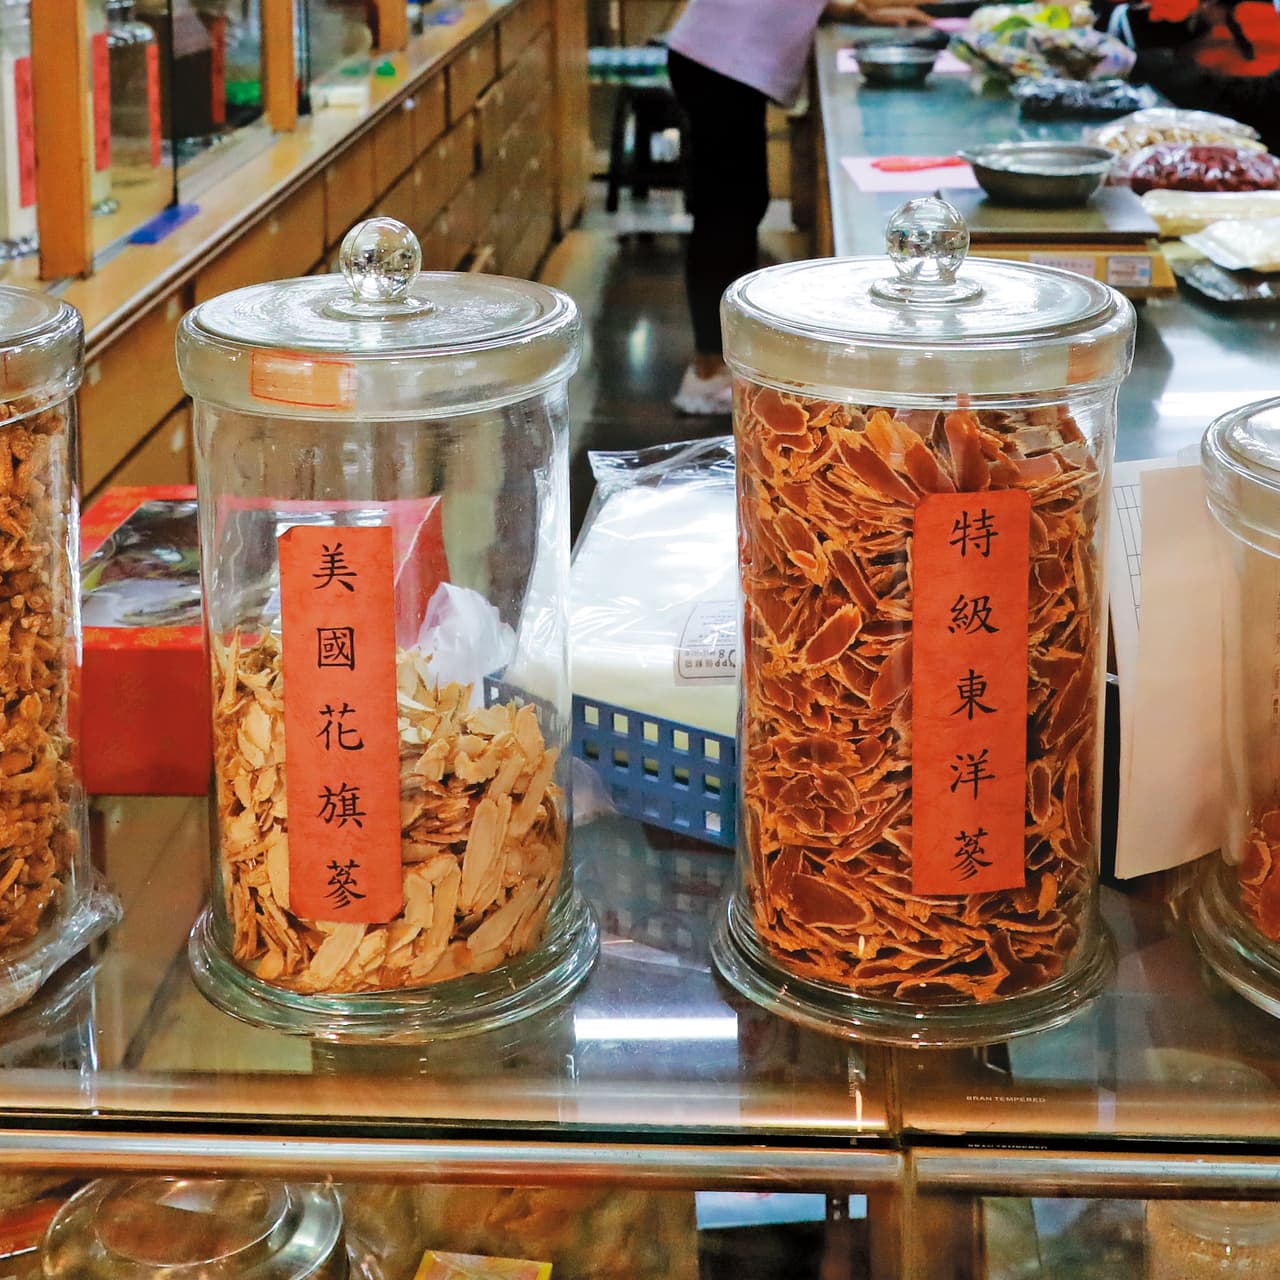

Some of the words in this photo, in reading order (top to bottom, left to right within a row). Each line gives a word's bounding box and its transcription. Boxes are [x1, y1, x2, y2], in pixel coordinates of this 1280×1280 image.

[312, 542, 368, 910] 美國花旗蔘
[948, 508, 1000, 882] 特級東洋蔘
